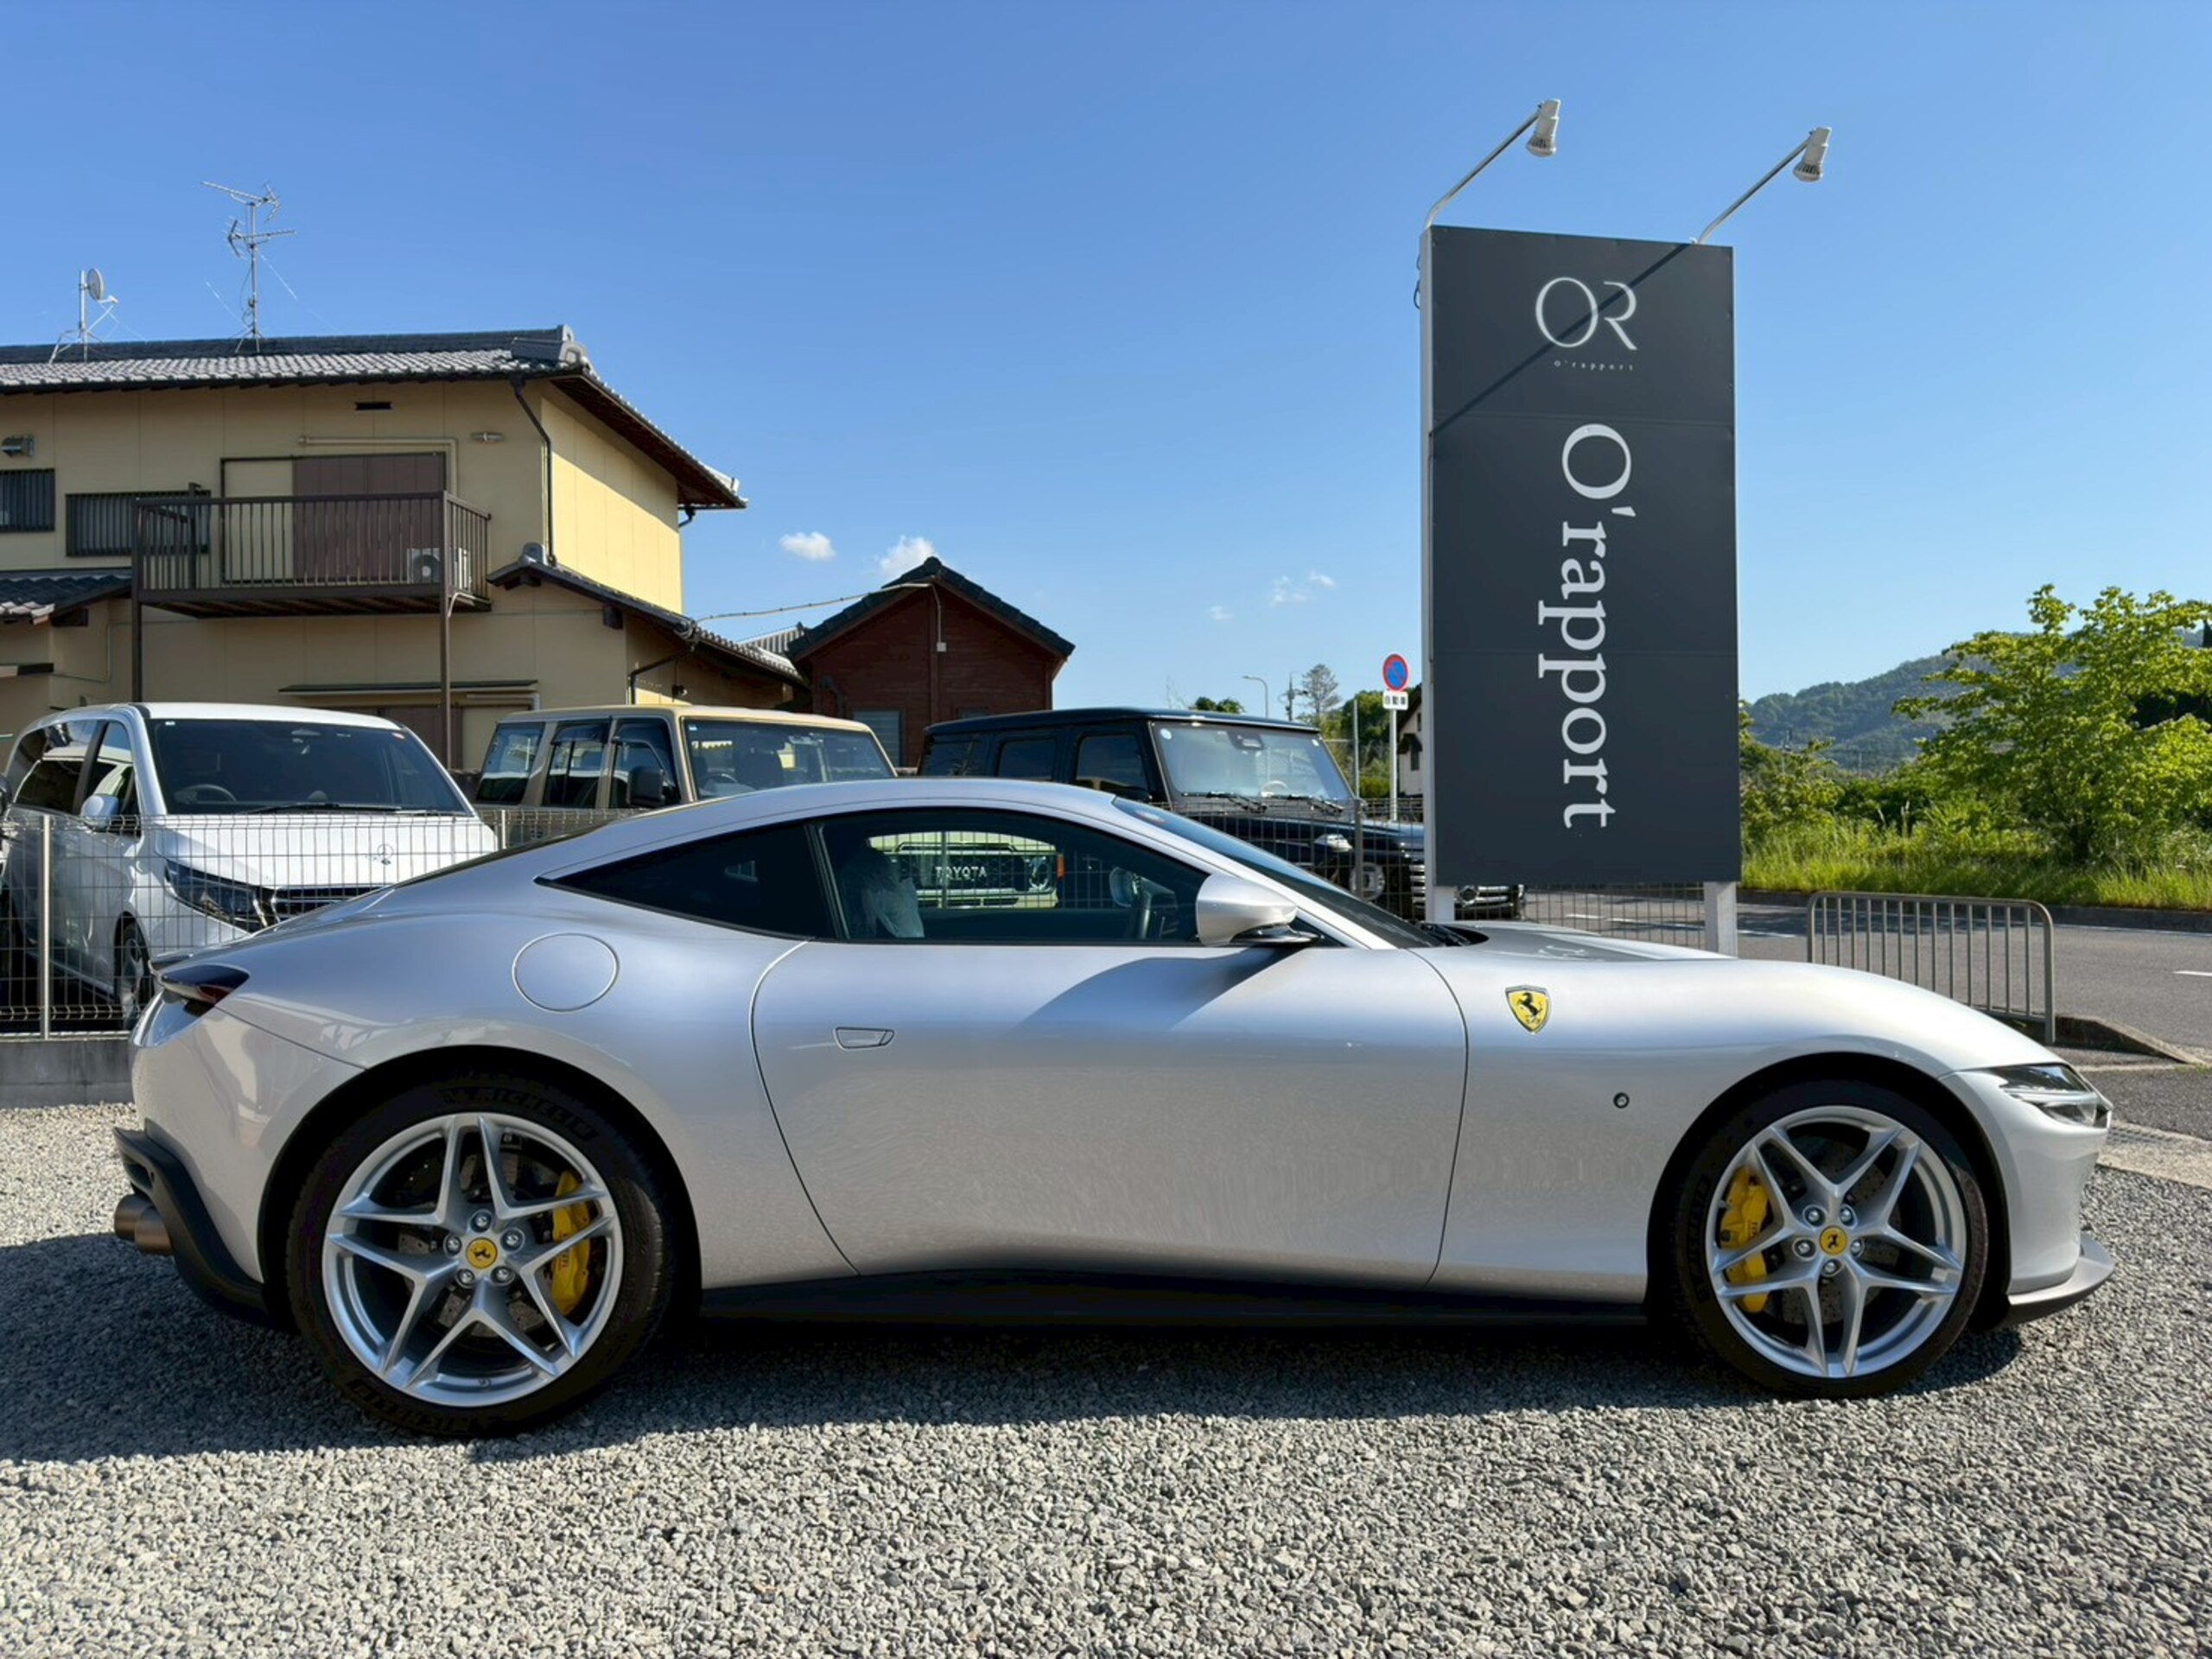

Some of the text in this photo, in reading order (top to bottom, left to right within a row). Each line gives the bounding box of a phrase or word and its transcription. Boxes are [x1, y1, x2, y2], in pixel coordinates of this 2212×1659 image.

[1535, 276, 1637, 350] OR
[1538, 423, 1637, 828] O'rapport
[935, 866, 987, 879] TOYOTA
